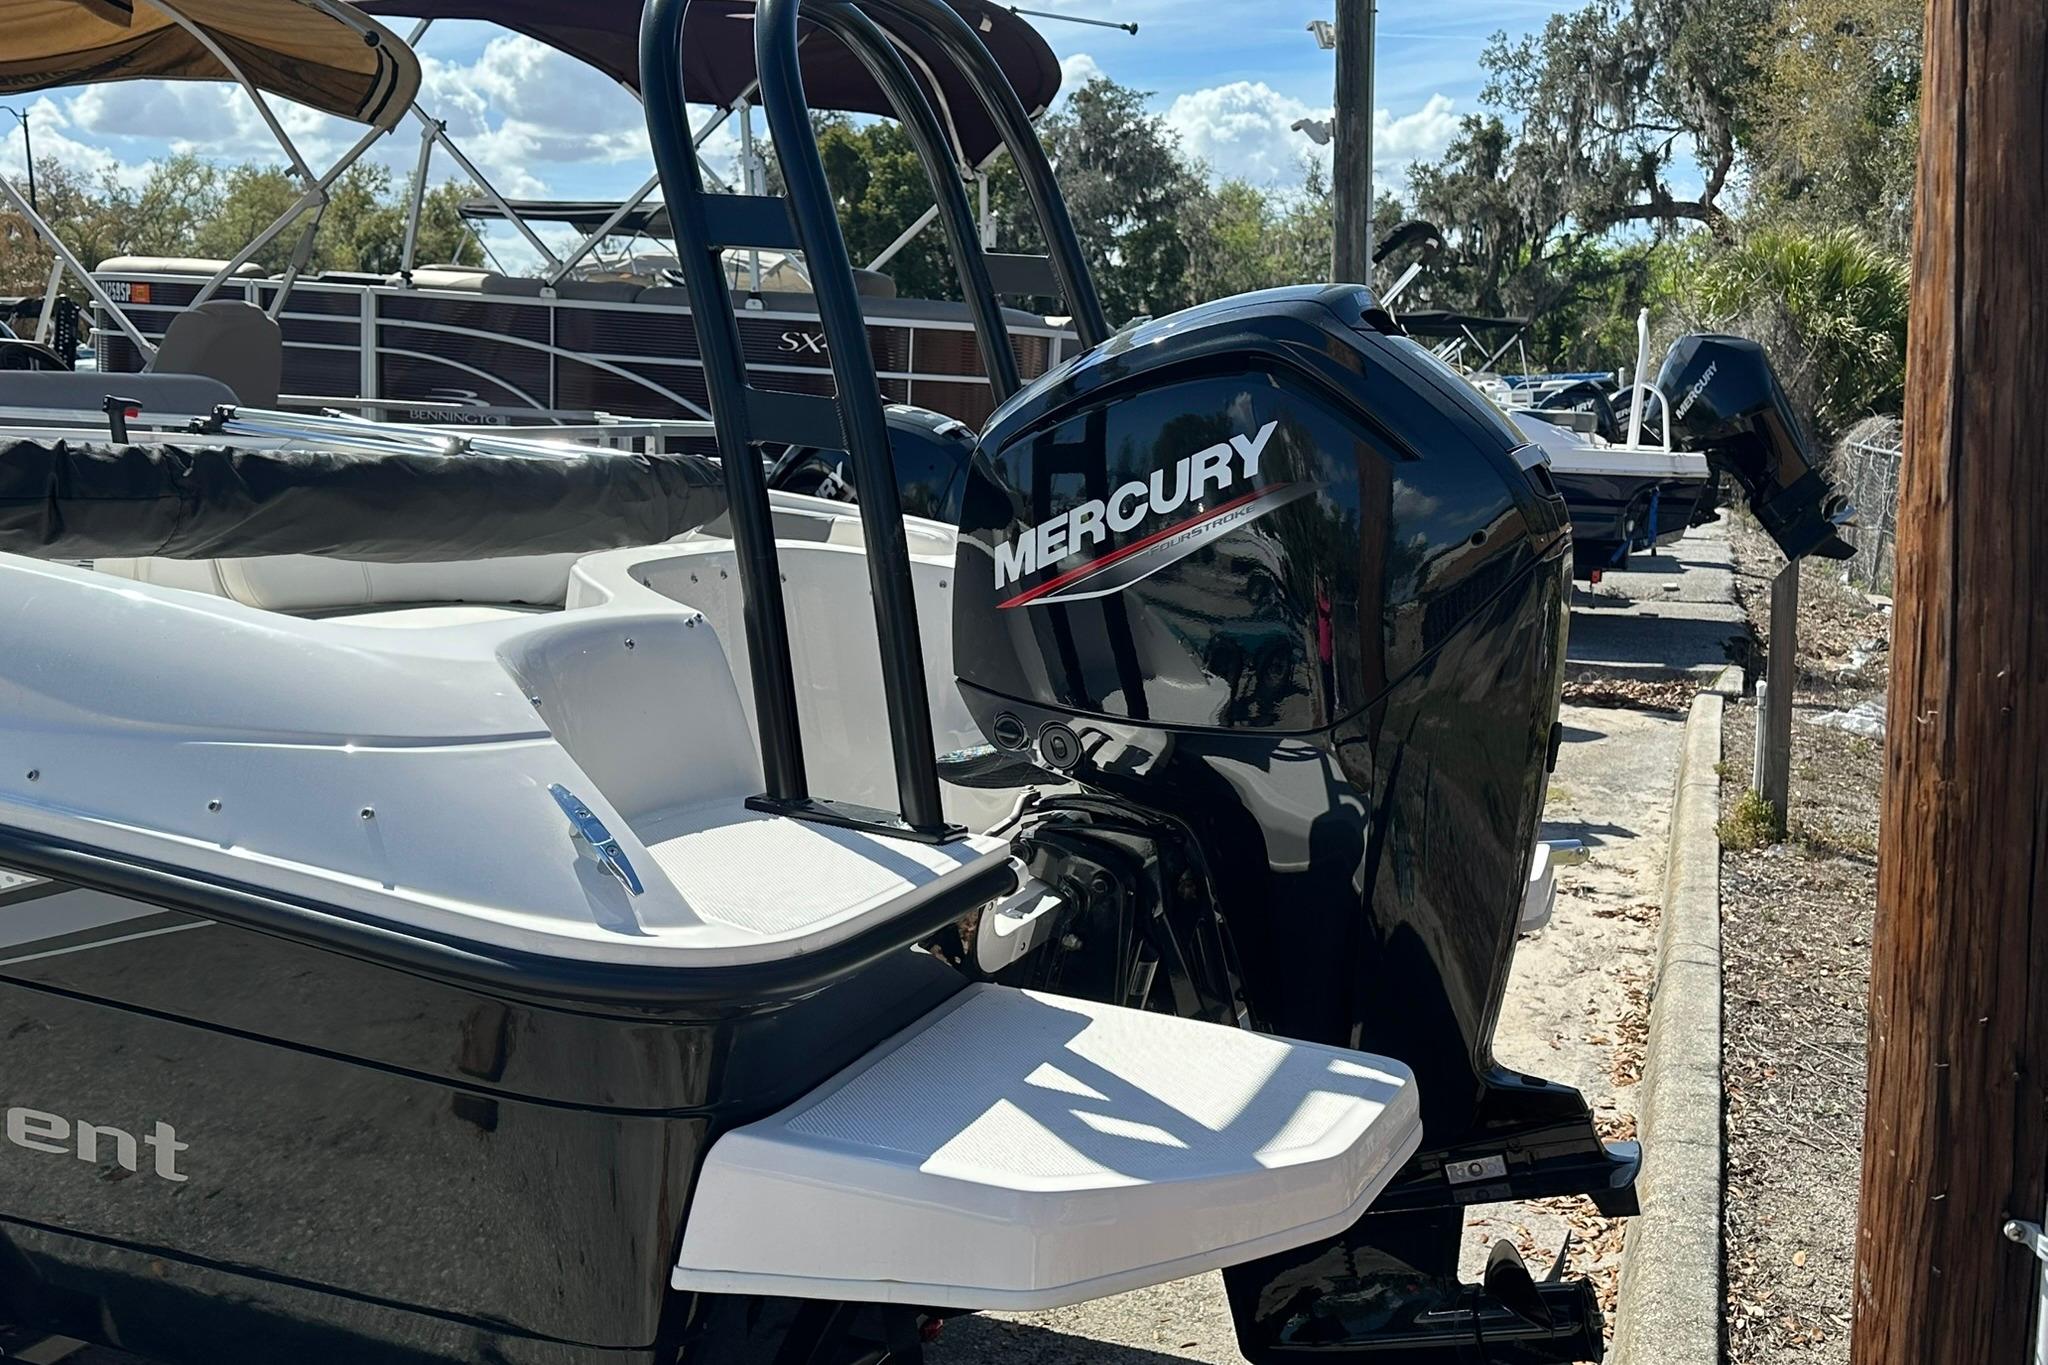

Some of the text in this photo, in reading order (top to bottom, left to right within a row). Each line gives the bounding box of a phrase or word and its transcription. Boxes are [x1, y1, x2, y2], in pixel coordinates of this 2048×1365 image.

[409, 407, 509, 426] BENNINGTO
[1675, 361, 1718, 420] MERCURY
[994, 420, 1279, 591] MERCURY
[1147, 503, 1256, 555] FOURSTROKE
[7, 1106, 190, 1182] ent
